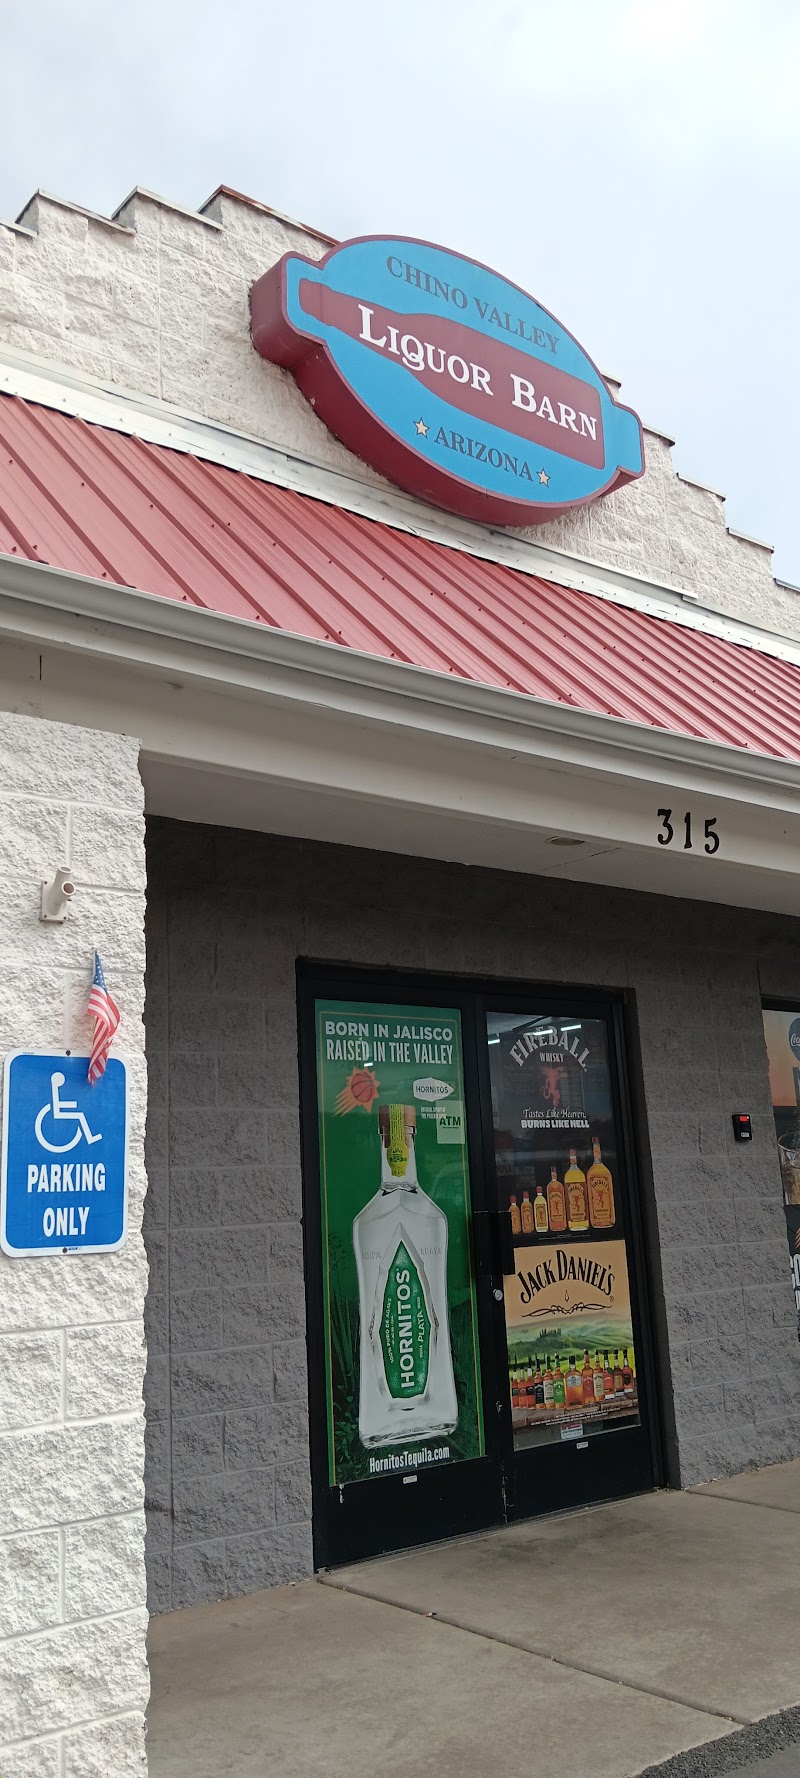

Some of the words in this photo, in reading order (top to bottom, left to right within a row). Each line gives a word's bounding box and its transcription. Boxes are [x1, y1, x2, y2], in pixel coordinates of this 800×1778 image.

[386, 255, 468, 310] CHINO
[469, 297, 560, 355] VALLEY
[357, 302, 494, 397] LIQUOR
[510, 373, 598, 441] BARN
[433, 426, 534, 483] ARIZONA
[657, 808, 720, 854] 315
[325, 1021, 369, 1037] BORN
[374, 1024, 389, 1038] IN
[393, 1025, 453, 1042] JALISCO
[509, 1025, 591, 1068] FIREBALL
[326, 1039, 370, 1061] RAISED
[373, 1041, 386, 1062] IN
[389, 1041, 411, 1063] THE
[413, 1043, 453, 1065] VALLEY
[539, 1052, 564, 1063] WHISKY
[415, 1085, 449, 1095] HORNITOS
[439, 1116, 461, 1127] ATM
[521, 1119, 551, 1129] BURNS
[551, 1119, 570, 1128] LIKE
[570, 1119, 590, 1128] HELL
[522, 1107, 544, 1118] Tastes
[546, 1107, 560, 1118] Like
[27, 1162, 106, 1193] PARKING
[43, 1206, 90, 1237] ONLY
[517, 1259, 557, 1304] JACK
[555, 1249, 616, 1297] DANIEL'S
[396, 1269, 415, 1388] HORNITOS
[417, 1310, 425, 1343] PLATA
[369, 1446, 450, 1474] HornitosTequila.com
